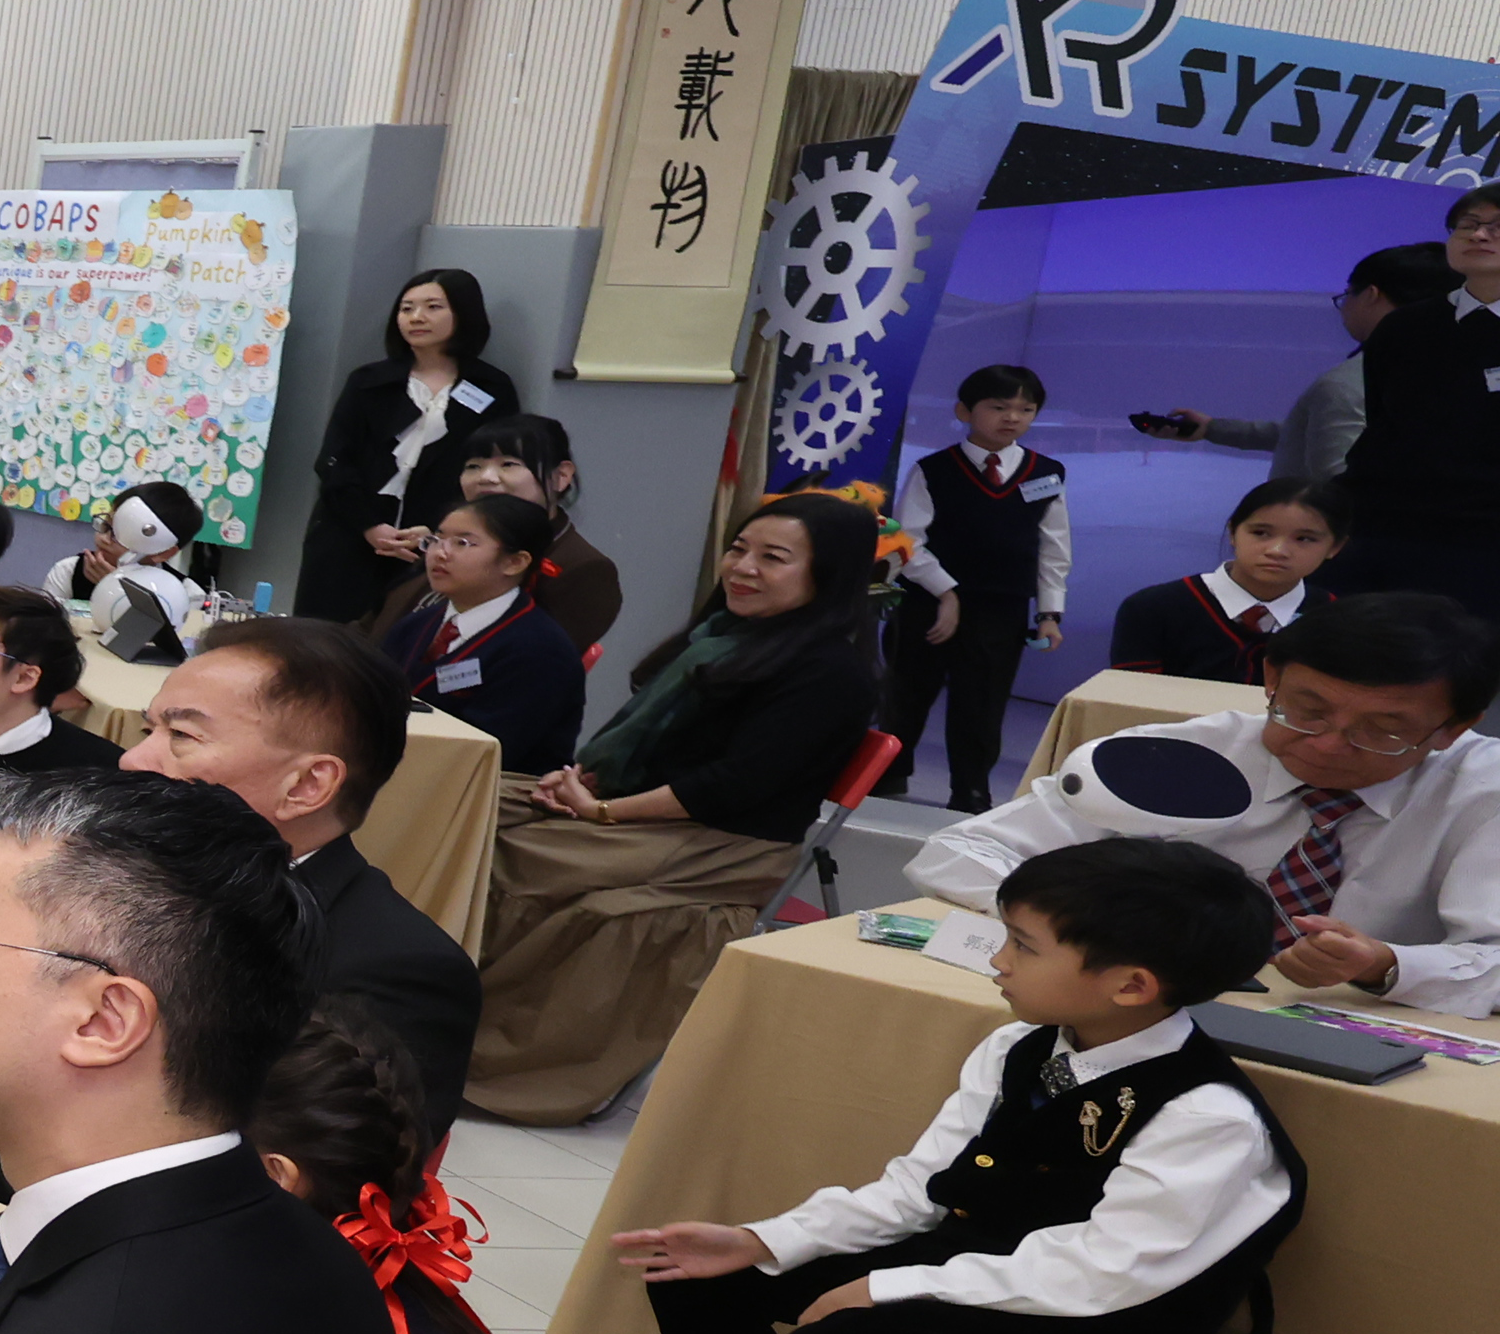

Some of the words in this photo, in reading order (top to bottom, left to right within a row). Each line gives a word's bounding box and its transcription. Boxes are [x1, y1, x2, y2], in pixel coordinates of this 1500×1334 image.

[1156, 47, 1500, 178] SYSTEM
[145, 222, 235, 246] Pumpkin
[35, 266, 44, 279] is
[47, 269, 68, 280] our
